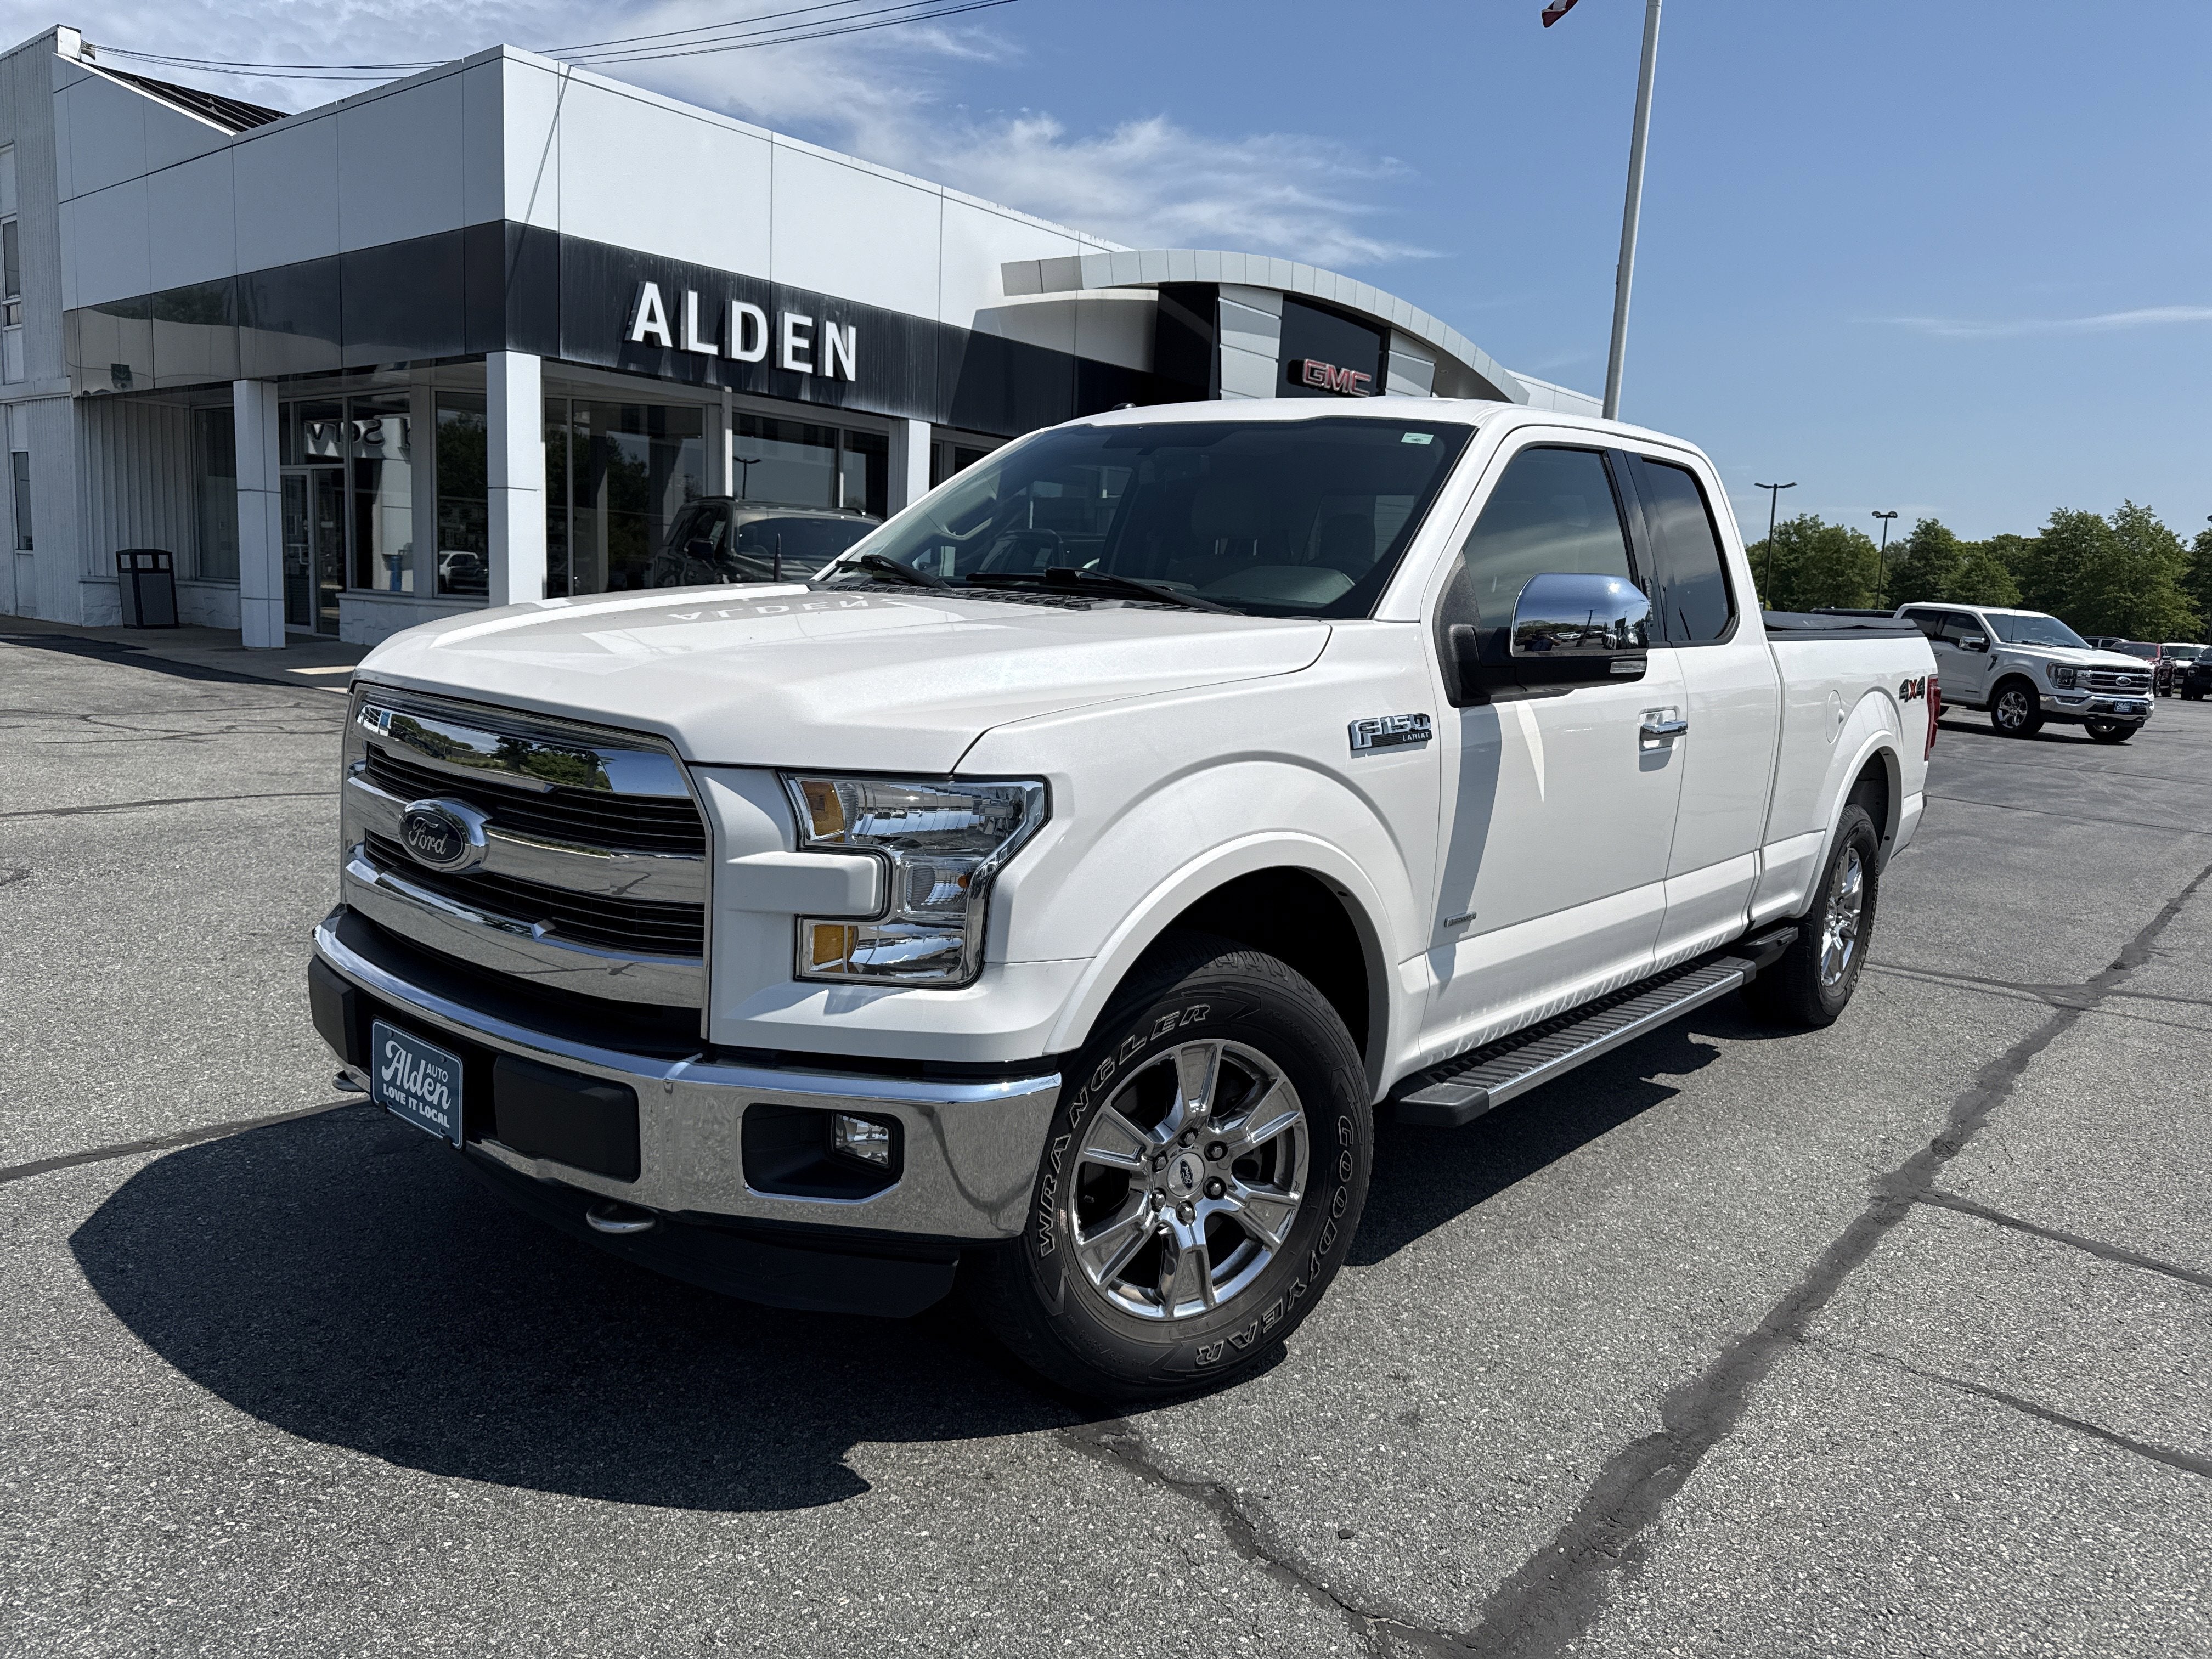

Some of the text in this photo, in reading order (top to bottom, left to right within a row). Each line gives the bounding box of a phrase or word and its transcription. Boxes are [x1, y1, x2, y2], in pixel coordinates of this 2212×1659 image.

[626, 281, 856, 382] ALDEN
[1302, 358, 1372, 398] GMC
[1402, 732, 1430, 741] LARIAT
[408, 816, 449, 855] Ford
[381, 1040, 452, 1110] Alden
[426, 1063, 449, 1083] AUTO
[382, 1083, 450, 1129] LOVE IT LOCAL
[1039, 1003, 1211, 1257] WRANGLER
[1182, 1165, 1192, 1184] Ford
[1195, 1115, 1354, 1368] GOODYEAR
